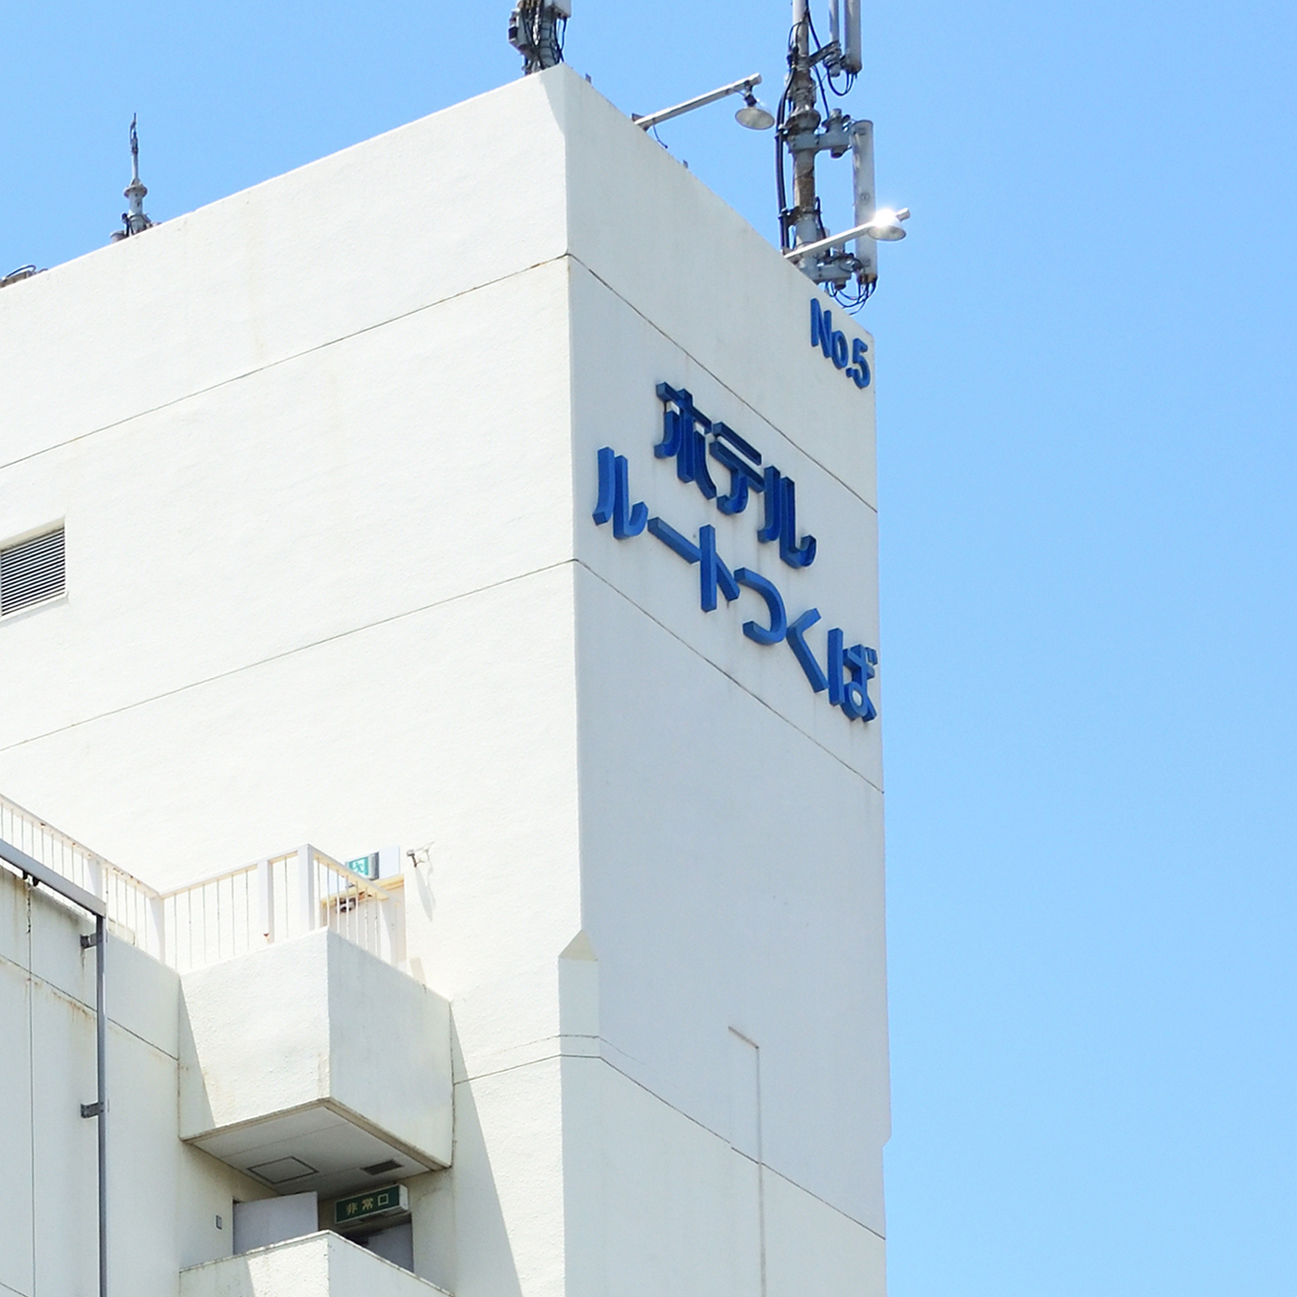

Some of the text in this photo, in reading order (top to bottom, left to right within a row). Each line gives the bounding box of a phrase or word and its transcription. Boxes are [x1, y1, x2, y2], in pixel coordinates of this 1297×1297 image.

[810, 298, 871, 390] No.5
[654, 382, 817, 569] ホテル
[592, 446, 878, 723] ルートつくば
[346, 1193, 389, 1216] 非常口
